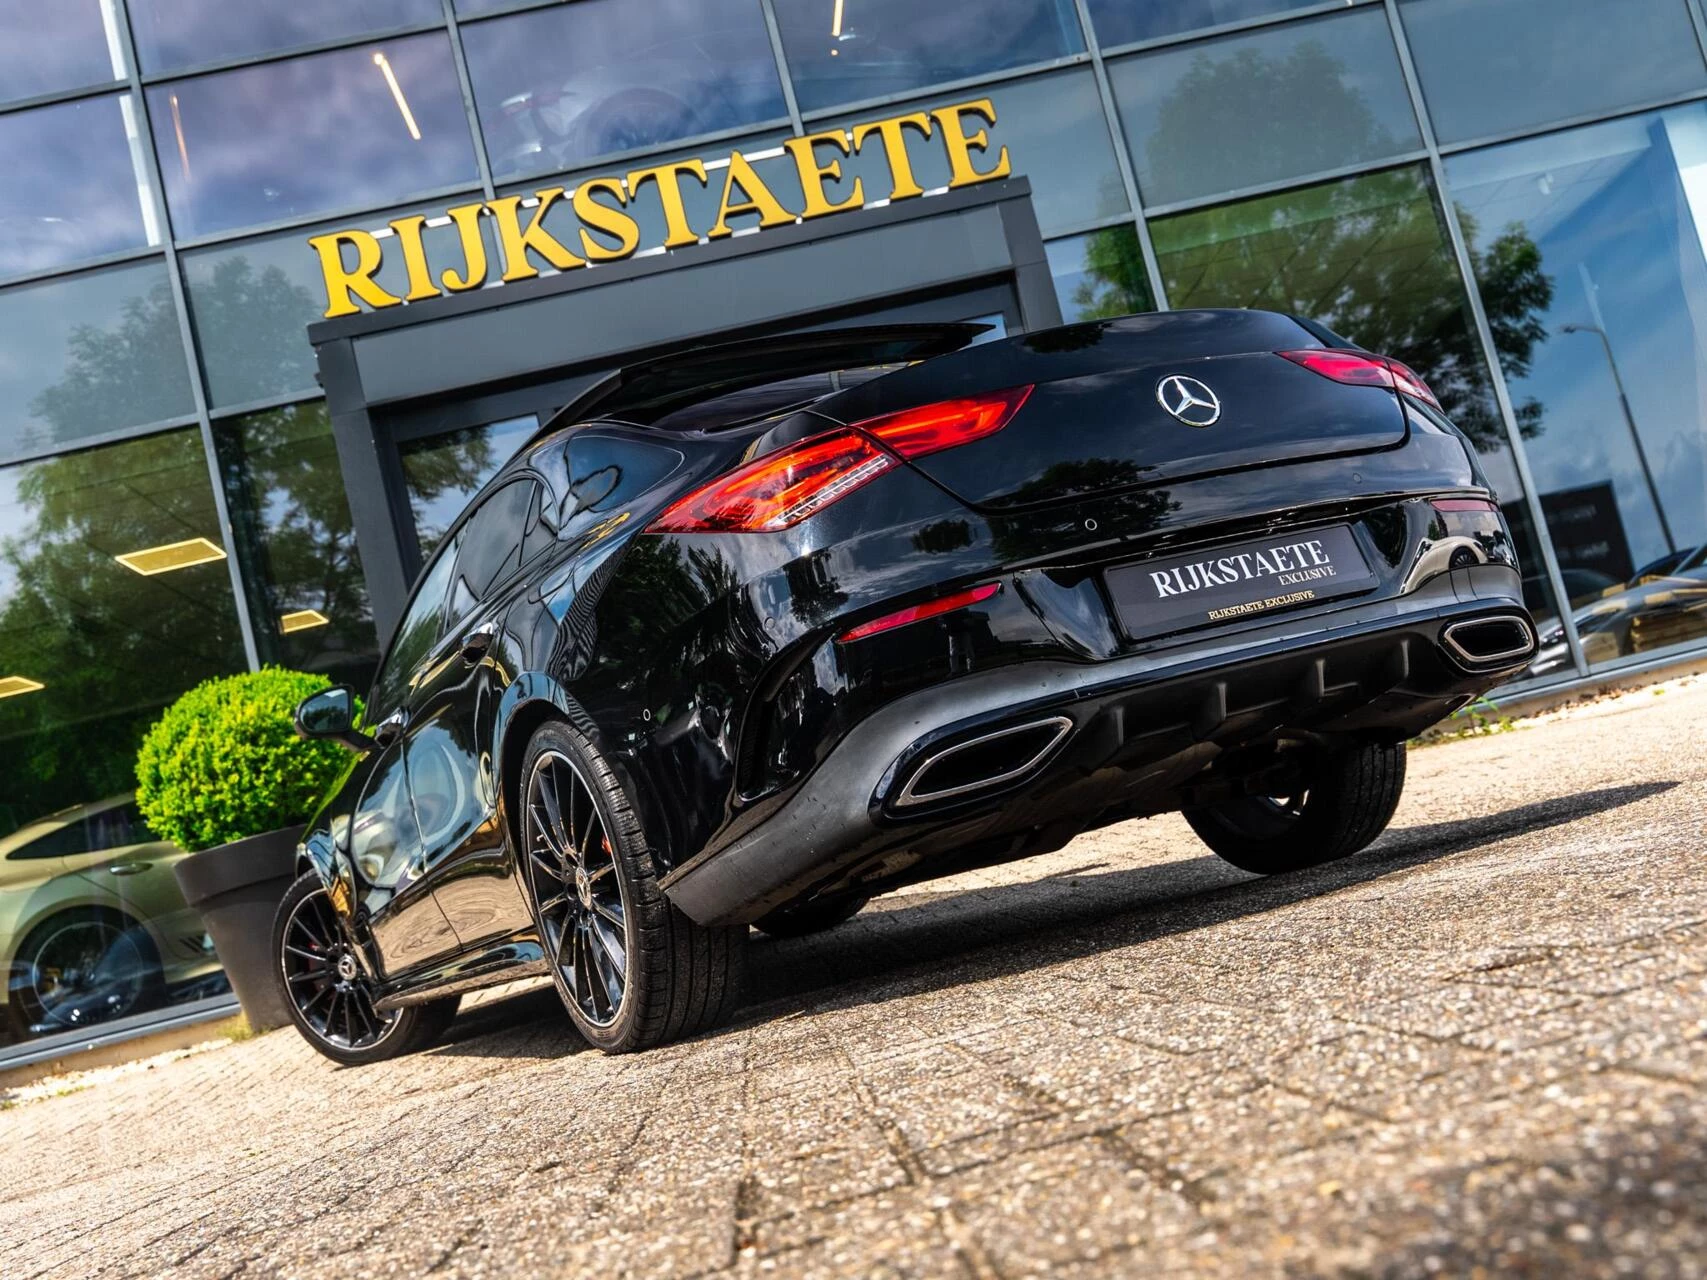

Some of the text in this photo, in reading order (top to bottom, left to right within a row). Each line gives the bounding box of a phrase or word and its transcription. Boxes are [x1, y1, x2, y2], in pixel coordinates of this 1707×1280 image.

[309, 98, 1011, 319] RIJKSTAETE
[1149, 540, 1331, 598] RIJKSTAETE
[1278, 565, 1337, 586] EXCLUSIVE
[1208, 589, 1315, 620] RIJKSTAETE EXCLUSIVE
